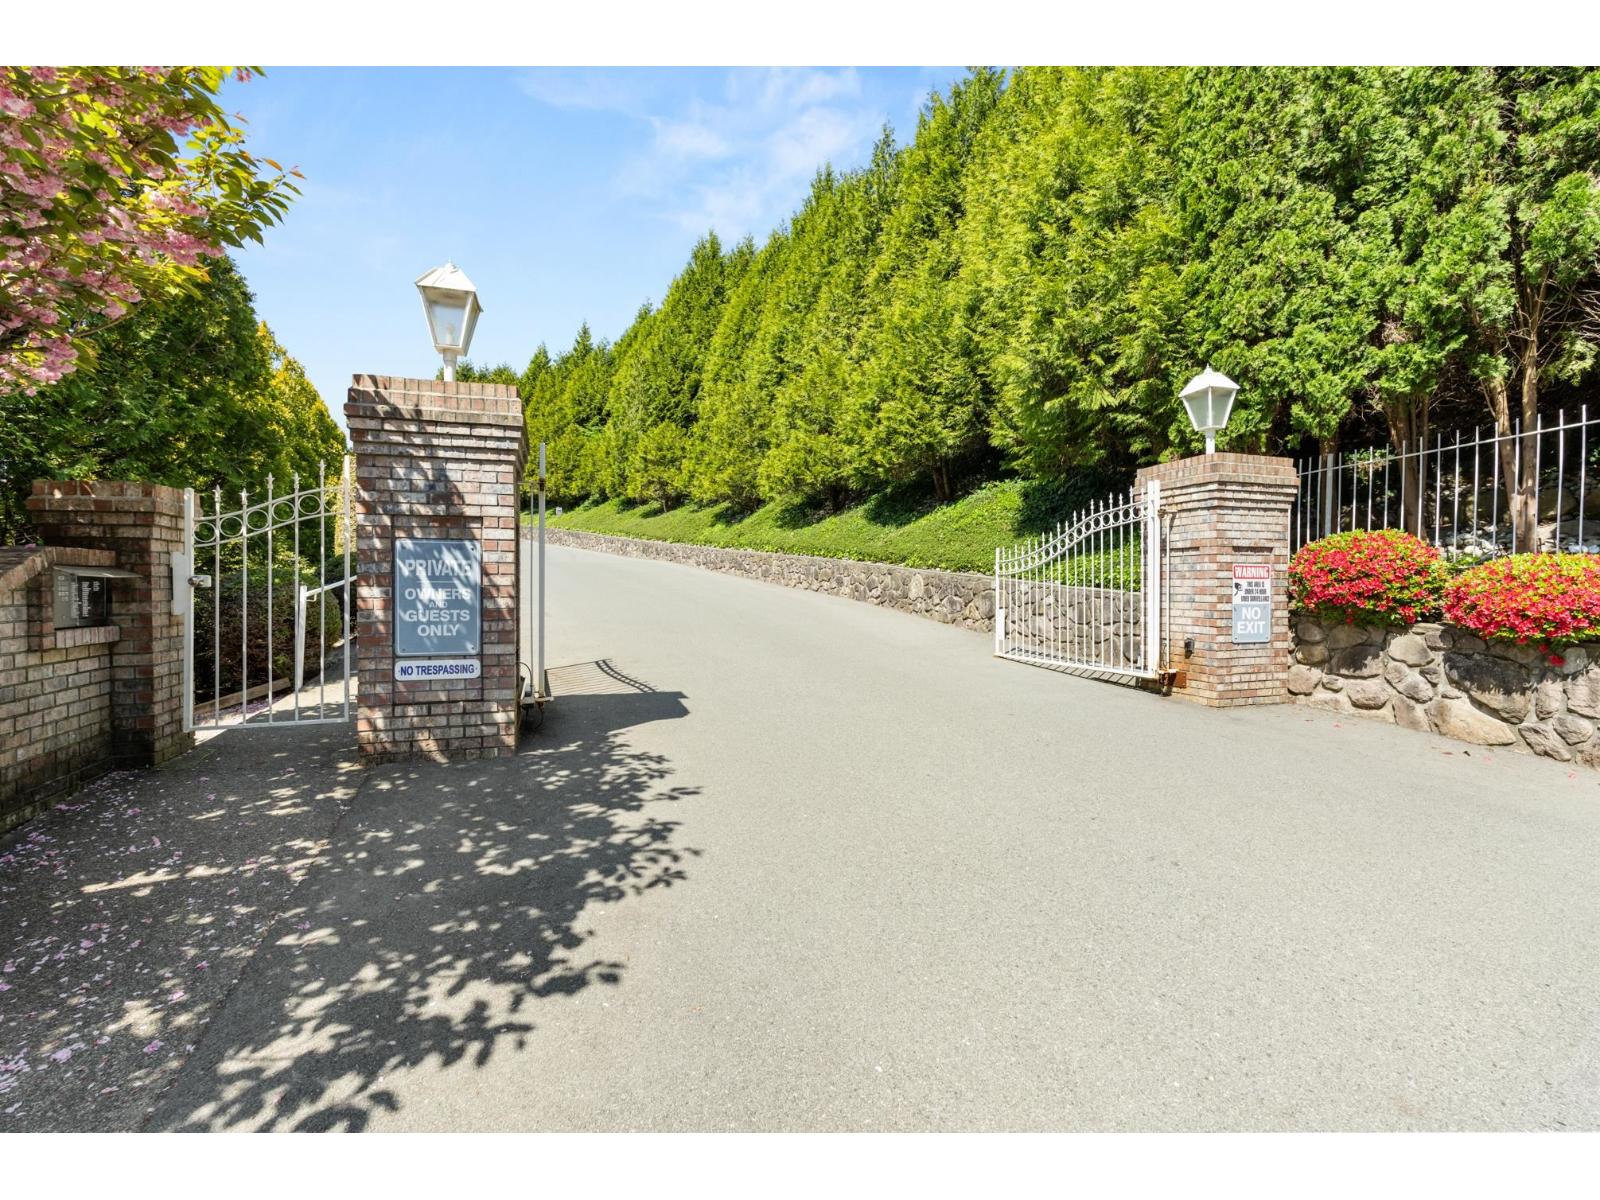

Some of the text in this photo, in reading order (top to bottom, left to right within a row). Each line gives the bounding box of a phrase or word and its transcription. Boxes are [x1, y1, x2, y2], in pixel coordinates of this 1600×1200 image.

[405, 559, 472, 576] PRIVATE
[1235, 568, 1269, 578] WARNING
[405, 588, 471, 600] OWNERS
[406, 610, 471, 621] GUESTS
[1242, 607, 1261, 620] NO
[417, 624, 460, 636] ONLY
[1237, 621, 1266, 634] EXIT
[400, 663, 474, 676] NO TRESPASSING
